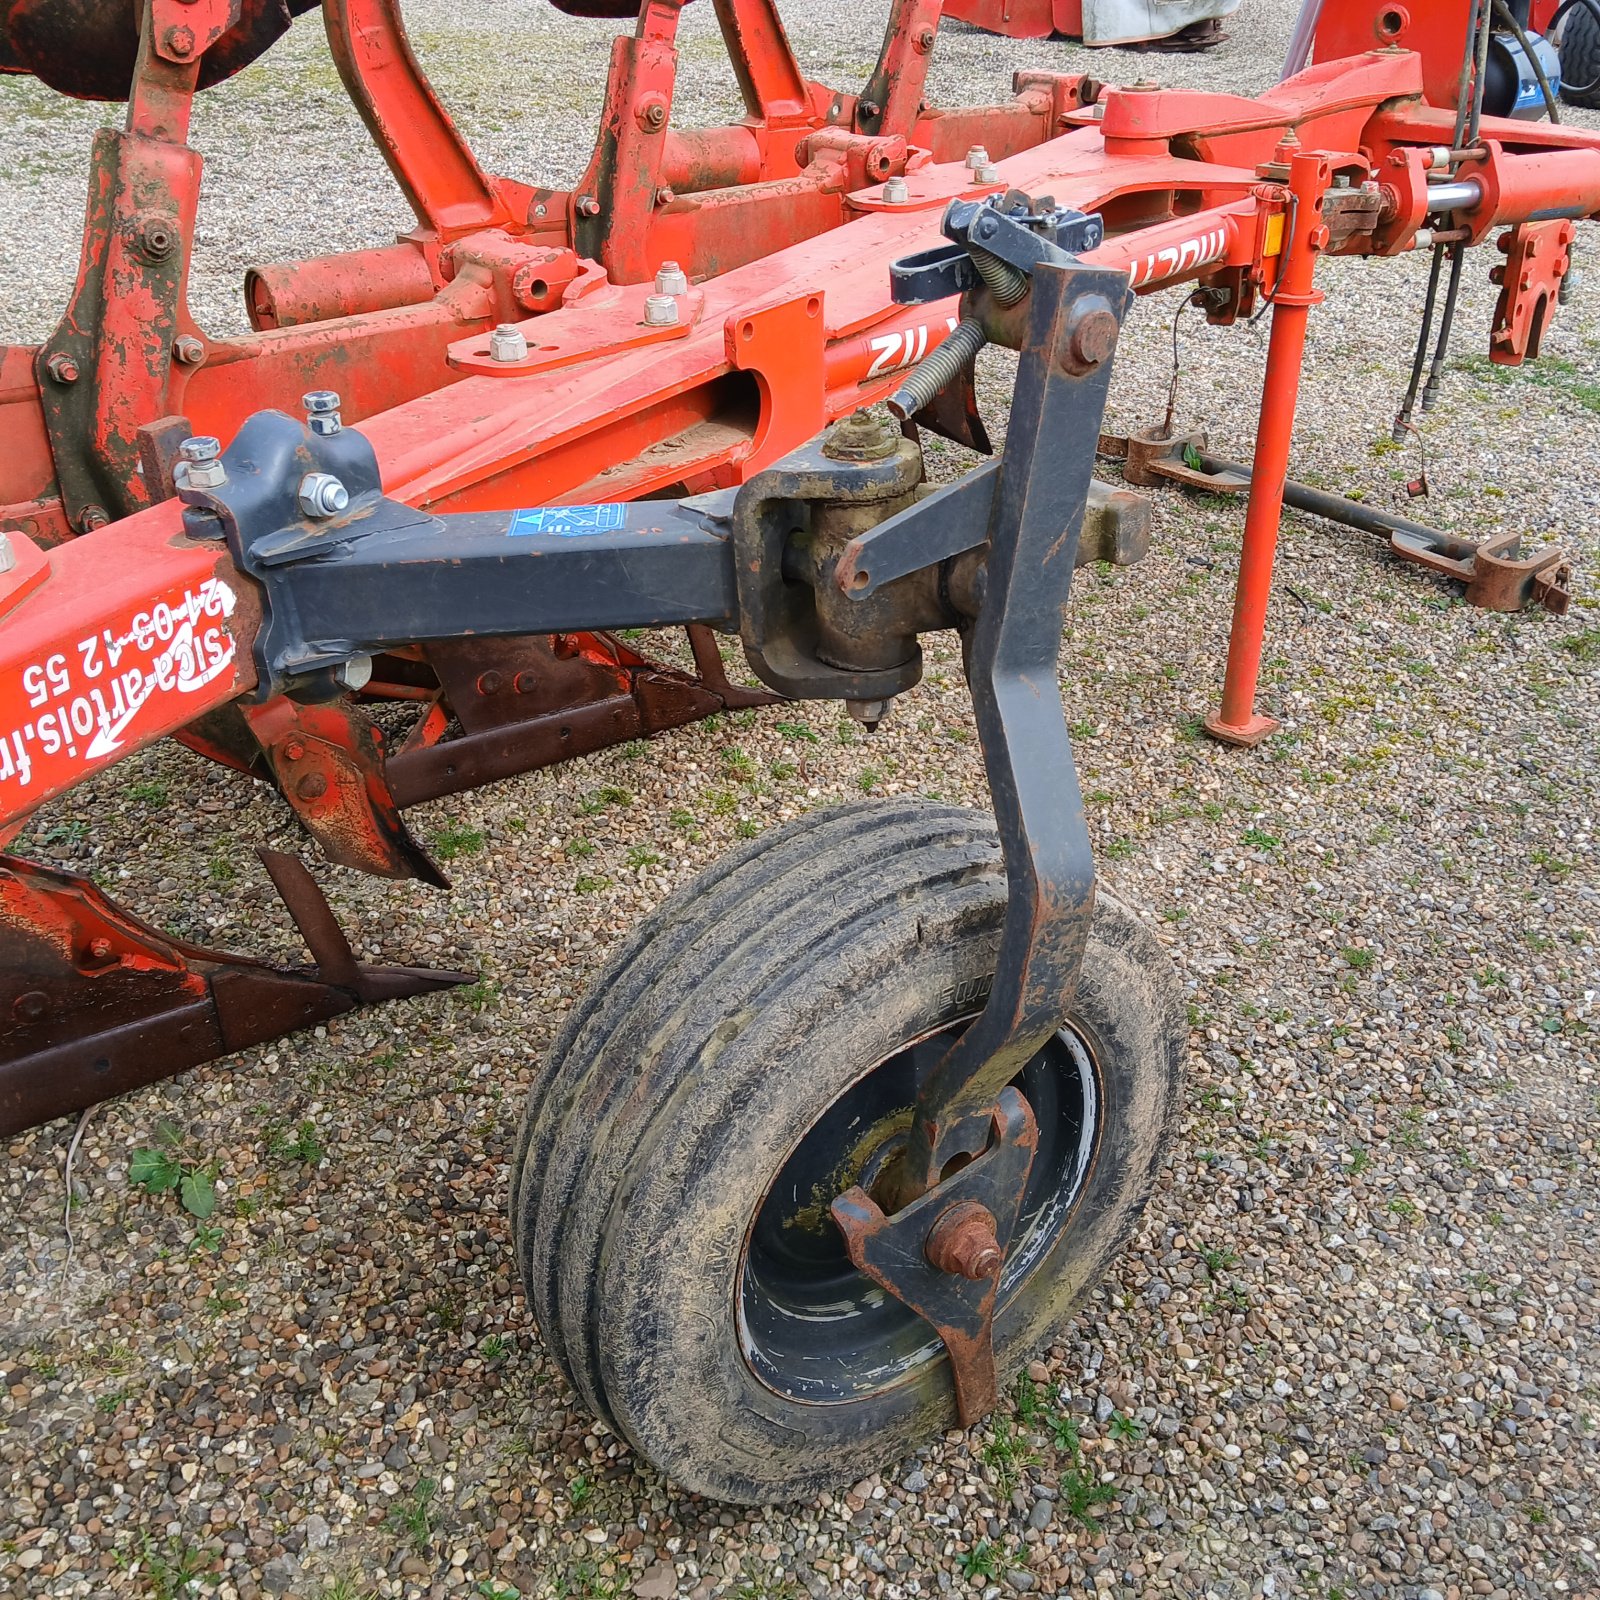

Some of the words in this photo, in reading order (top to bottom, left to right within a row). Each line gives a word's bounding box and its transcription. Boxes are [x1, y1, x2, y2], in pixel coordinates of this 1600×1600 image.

[132, 602, 174, 651] 03
[184, 577, 223, 627] 21
[77, 629, 123, 679] 12
[23, 653, 71, 708] 55
[0, 627, 224, 786] sica-artois.fr
